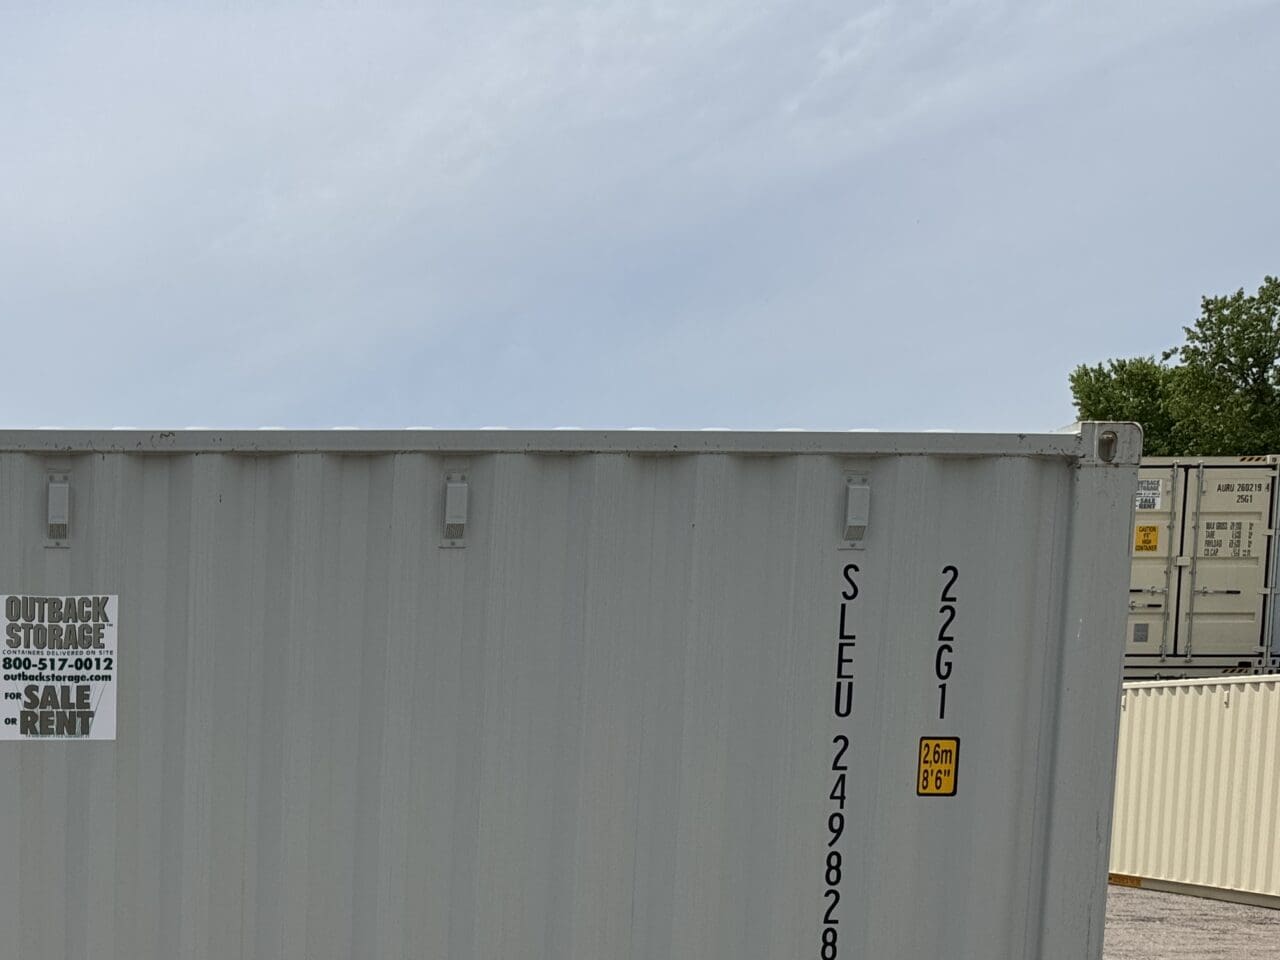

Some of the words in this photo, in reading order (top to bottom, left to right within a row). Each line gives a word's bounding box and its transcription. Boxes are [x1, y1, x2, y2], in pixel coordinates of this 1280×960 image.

[1217, 483, 1235, 492] AURU
[1237, 483, 1262, 492] 260219
[1236, 494, 1253, 504] 25G1
[5, 596, 109, 623] OUTBACK
[6, 623, 105, 650] STORAGE
[835, 563, 859, 718] SLEU
[935, 565, 959, 719] 22G1
[2, 657, 113, 671] 800-517-0012
[3, 672, 112, 683] outbackstorage.com
[4, 692, 22, 700] FOR
[23, 684, 91, 710] SALE
[20, 711, 94, 735] RENT
[922, 743, 953, 768] 2,6m
[921, 769, 951, 790] 8'6"
